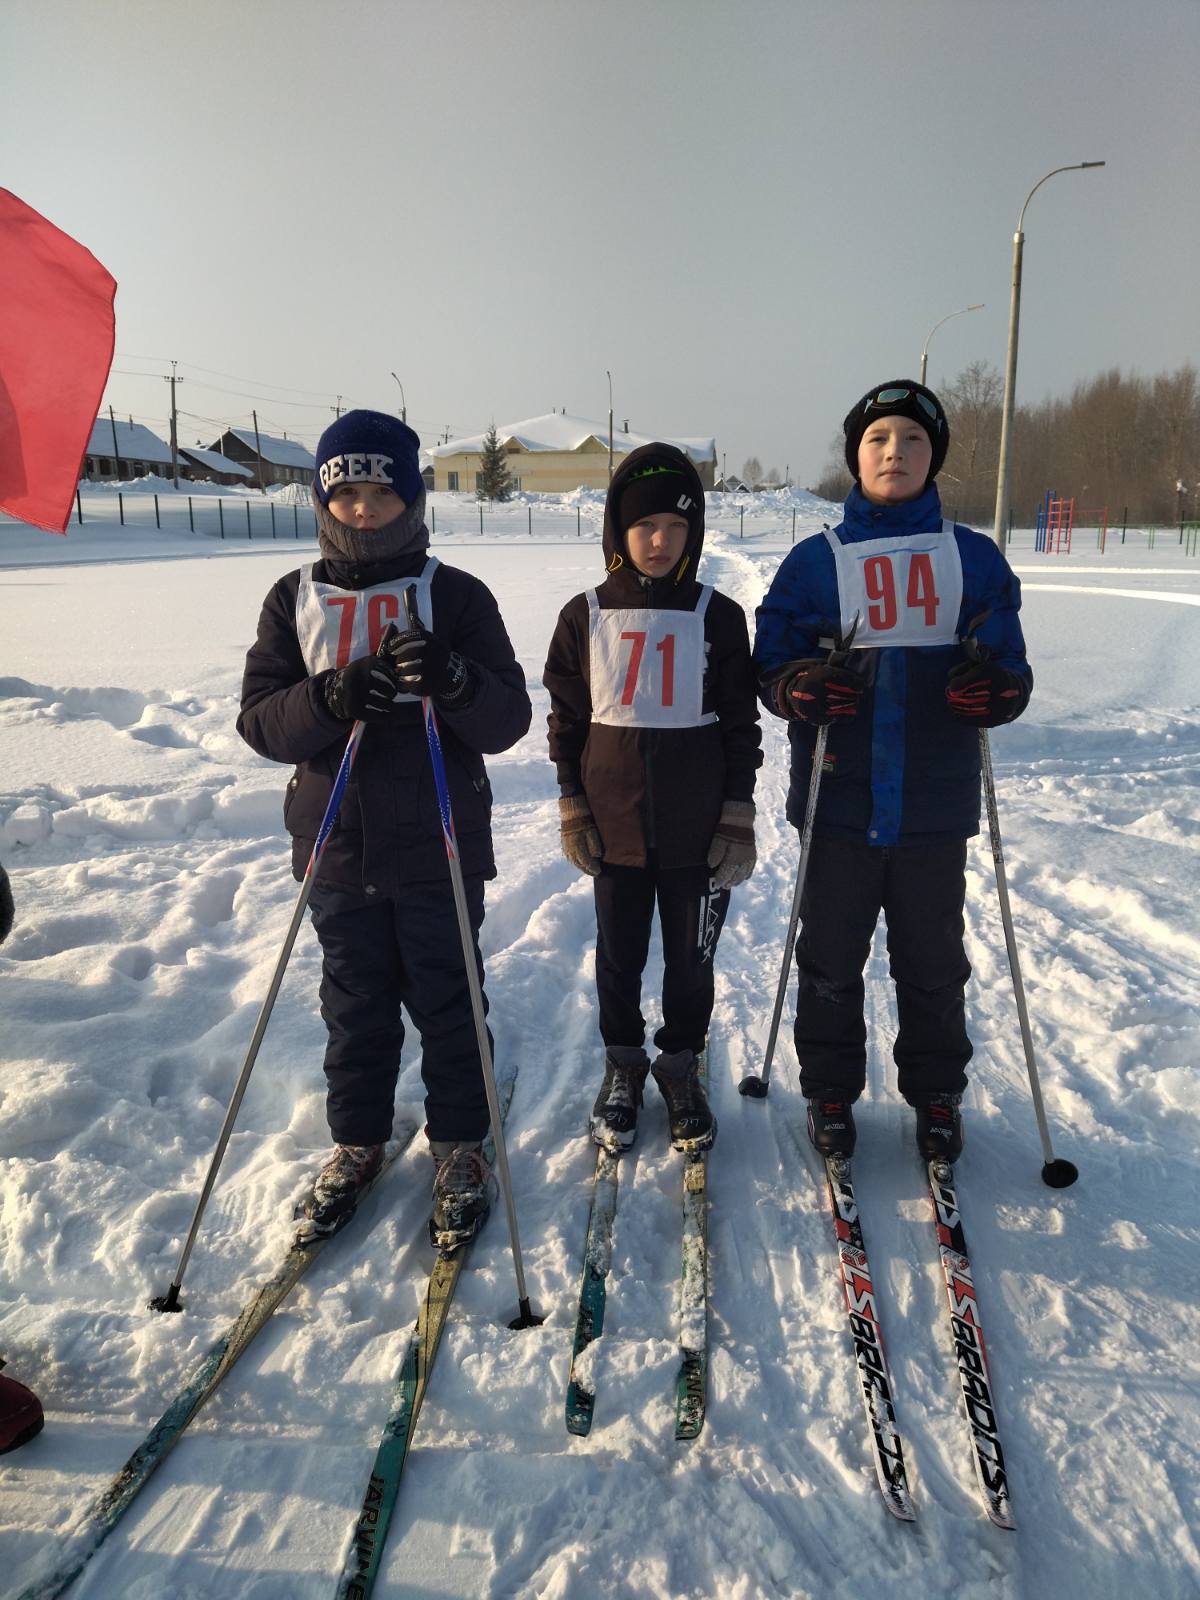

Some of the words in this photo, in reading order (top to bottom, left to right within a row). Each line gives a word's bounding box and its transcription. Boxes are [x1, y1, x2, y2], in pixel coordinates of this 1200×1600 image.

[319, 453, 394, 493] GEEK
[863, 553, 940, 631] 94
[620, 631, 675, 707] 71
